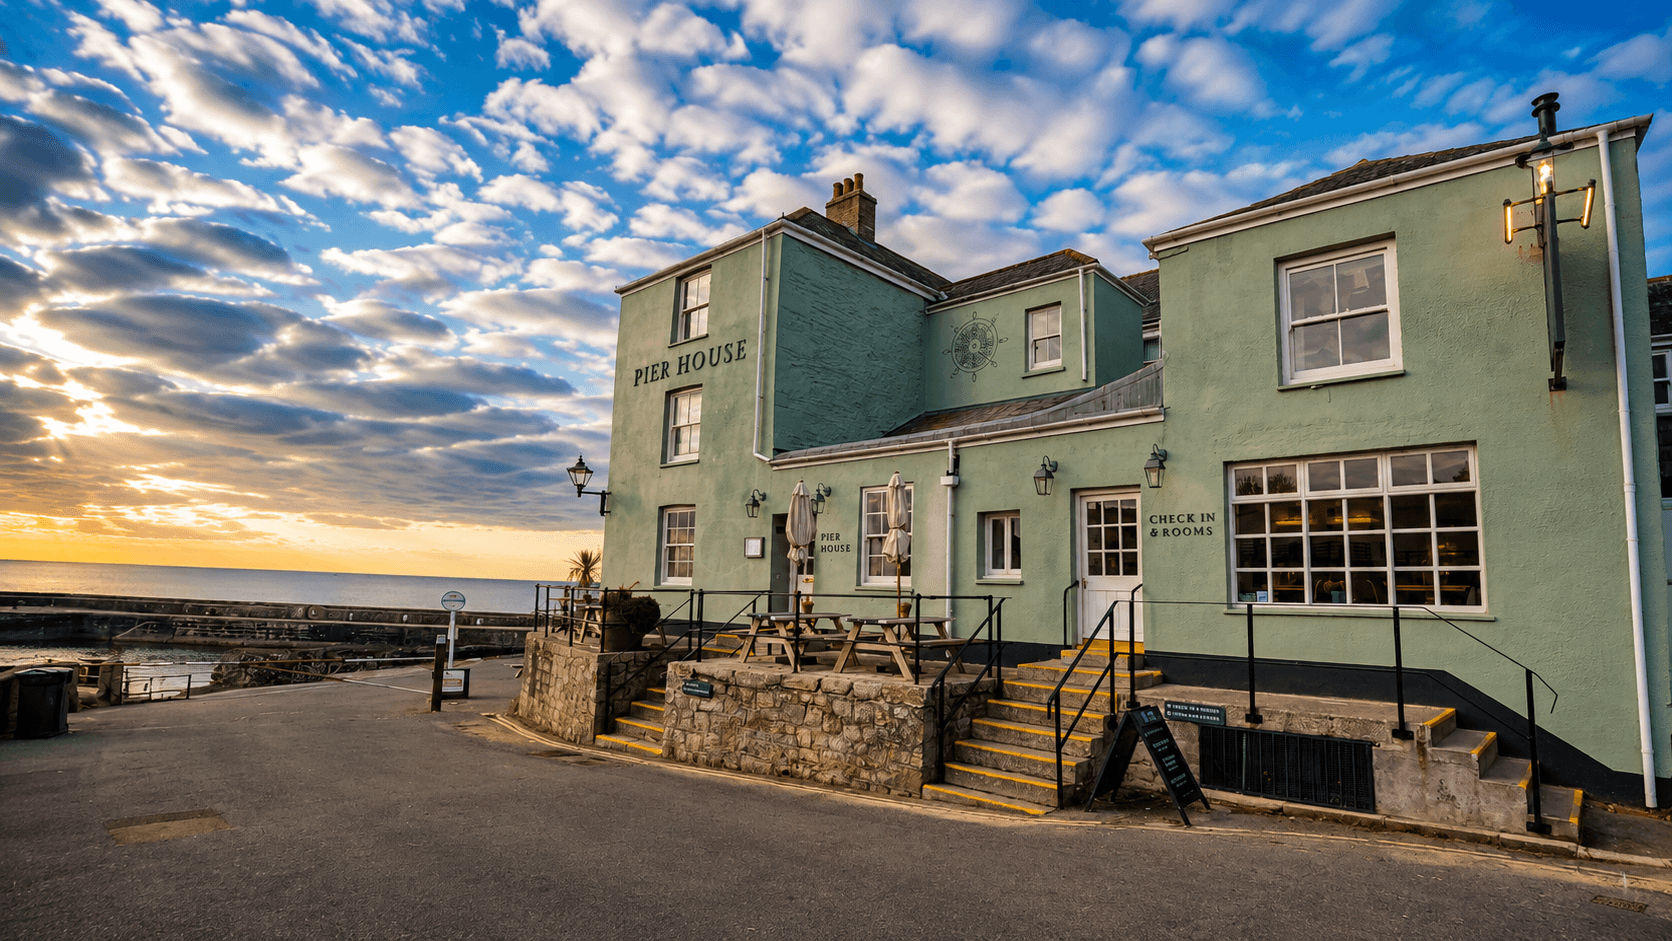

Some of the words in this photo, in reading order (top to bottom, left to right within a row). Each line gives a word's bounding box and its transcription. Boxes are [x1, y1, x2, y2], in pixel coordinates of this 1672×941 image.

[633, 360, 670, 387] PIER
[676, 339, 747, 375] HOUSE
[1149, 513, 1195, 524] CHECK
[1200, 512, 1215, 522] IN
[821, 533, 840, 541] PIER
[1149, 528, 1158, 537] &
[1162, 526, 1213, 537] ROOMS
[821, 544, 851, 552] HOUSE
